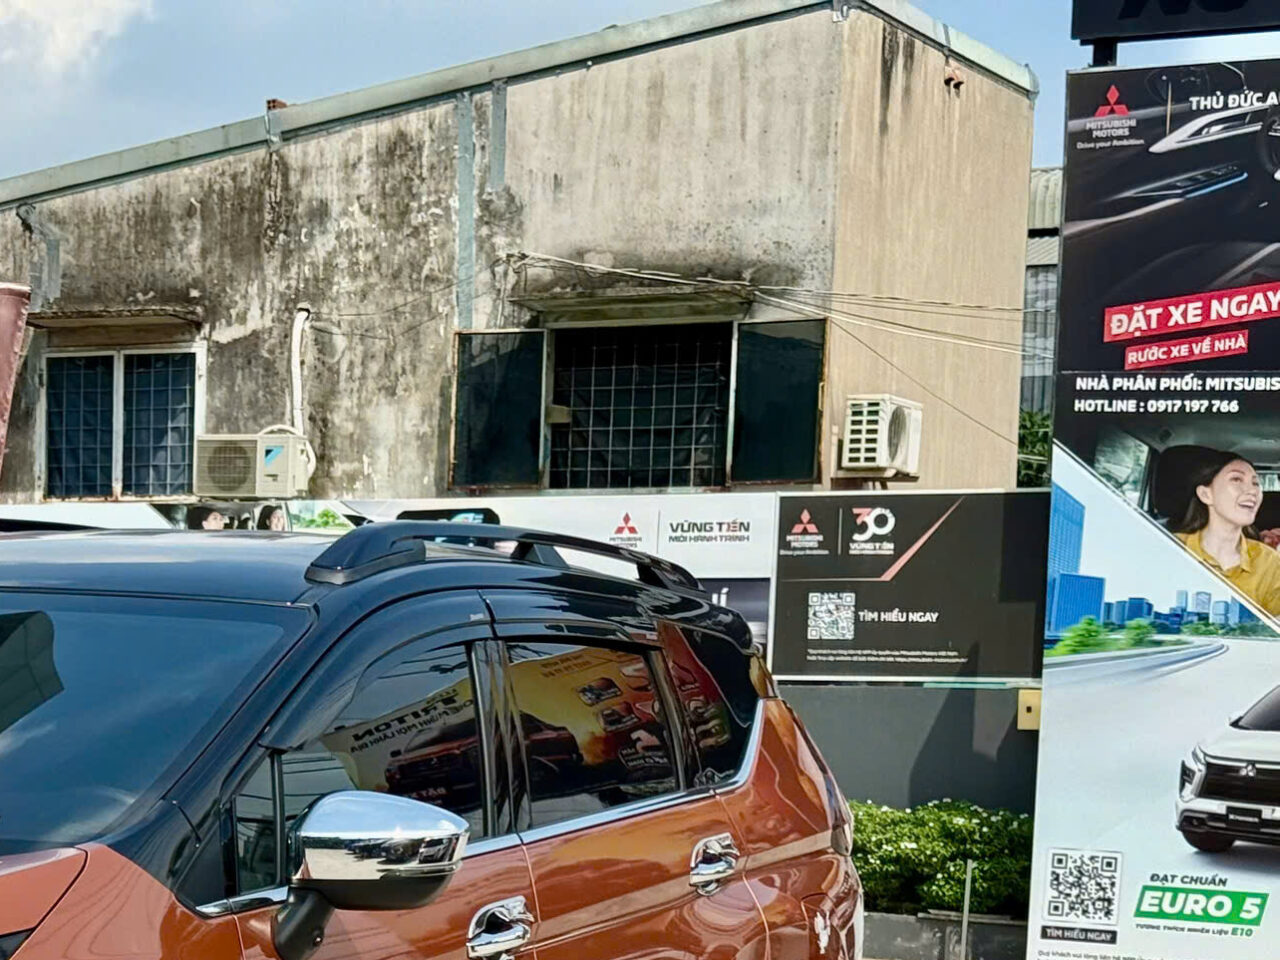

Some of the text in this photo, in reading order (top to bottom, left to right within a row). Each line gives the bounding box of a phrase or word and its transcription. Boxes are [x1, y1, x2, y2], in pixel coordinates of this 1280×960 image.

[1189, 90, 1224, 110] THỦ
[1228, 86, 1264, 108] ĐỨC
[1086, 118, 1136, 130] MITSUBISHI
[1092, 128, 1130, 138] MOTORS
[1077, 140, 1095, 149] Drive
[1095, 140, 1112, 149] your
[1110, 289, 1280, 337] ĐẶT XE NGAY
[1128, 334, 1247, 365] RƯỚC XE VỀ NHÀ
[1076, 374, 1110, 391] NHÀ
[1112, 375, 1156, 391] PHÂN
[1160, 373, 1203, 391] PHỐI:
[1074, 400, 1137, 413] HOTLINE
[1147, 400, 1181, 413] 0917
[1184, 400, 1209, 413] 197
[1212, 400, 1239, 413] 766
[858, 608, 939, 622] TÌM HIỂU NGAY
[1150, 873, 1178, 886] ĐẠT
[1140, 889, 1262, 919] EURO 5
[1045, 927, 1112, 941] TÌM HIỂU NGAY
[1231, 927, 1253, 937] E10
